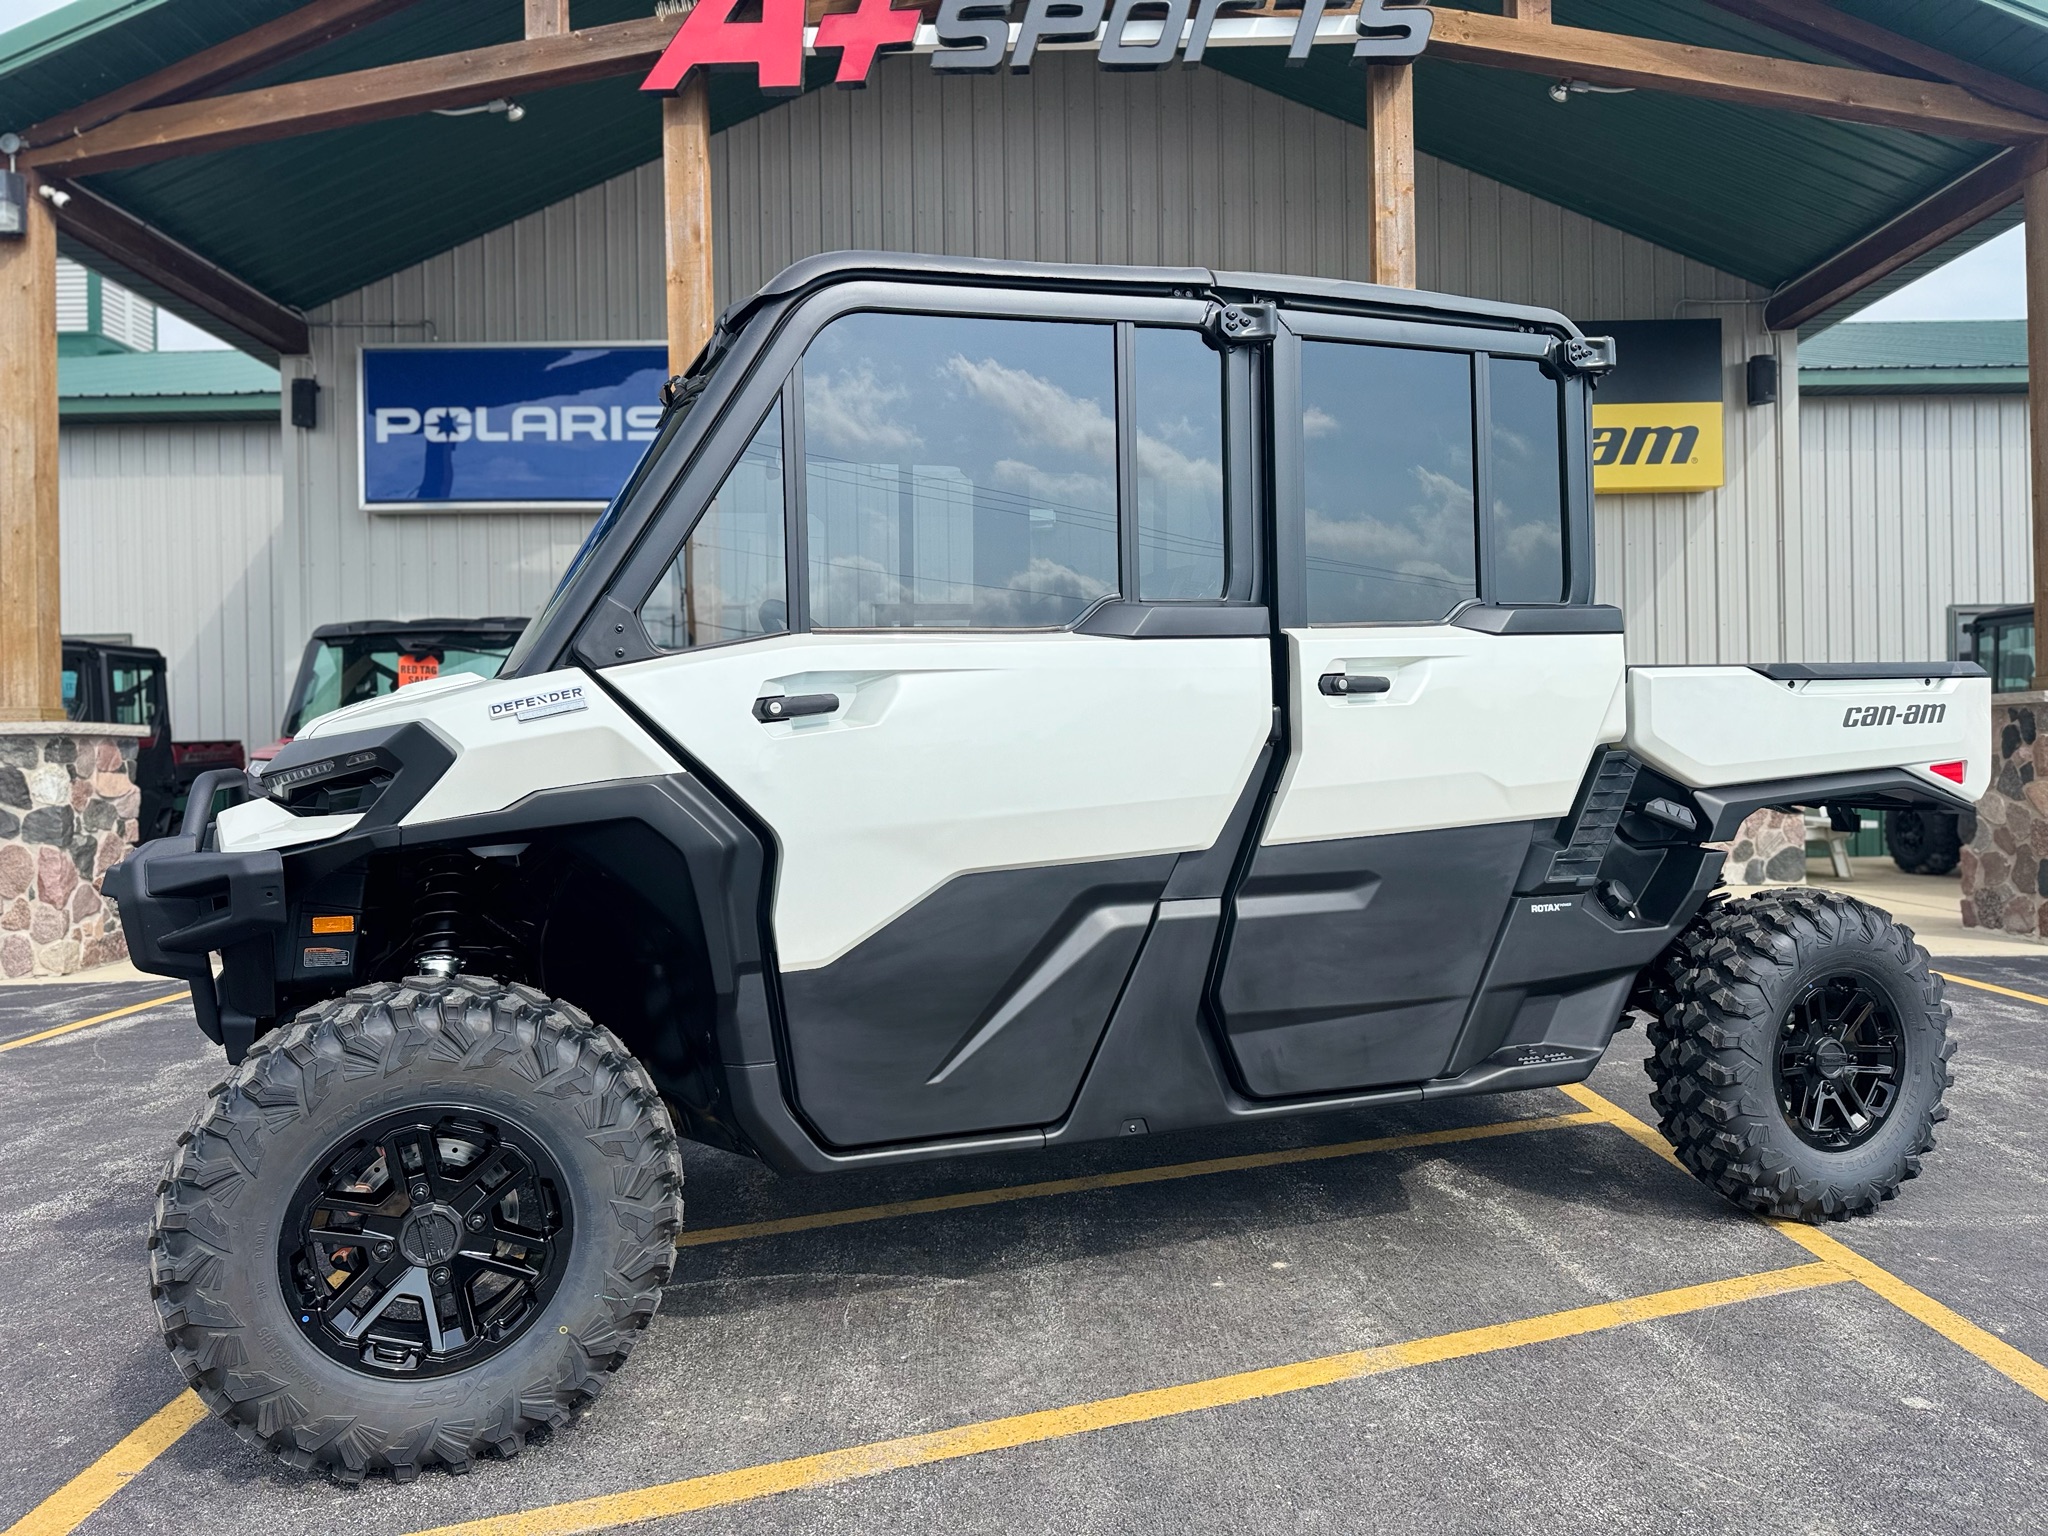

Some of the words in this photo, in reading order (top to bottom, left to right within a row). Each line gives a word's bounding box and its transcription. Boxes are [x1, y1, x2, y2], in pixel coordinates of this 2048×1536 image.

[376, 405, 664, 443] POLARIS
[400, 665, 418, 674] RED
[420, 665, 437, 675] TAG
[491, 687, 583, 714] DEFENDER
[1842, 703, 1947, 728] can-am
[1530, 903, 1561, 913] ROTAX
[419, 1080, 538, 1116] FORCE
[255, 1221, 269, 1259] RADIAL
